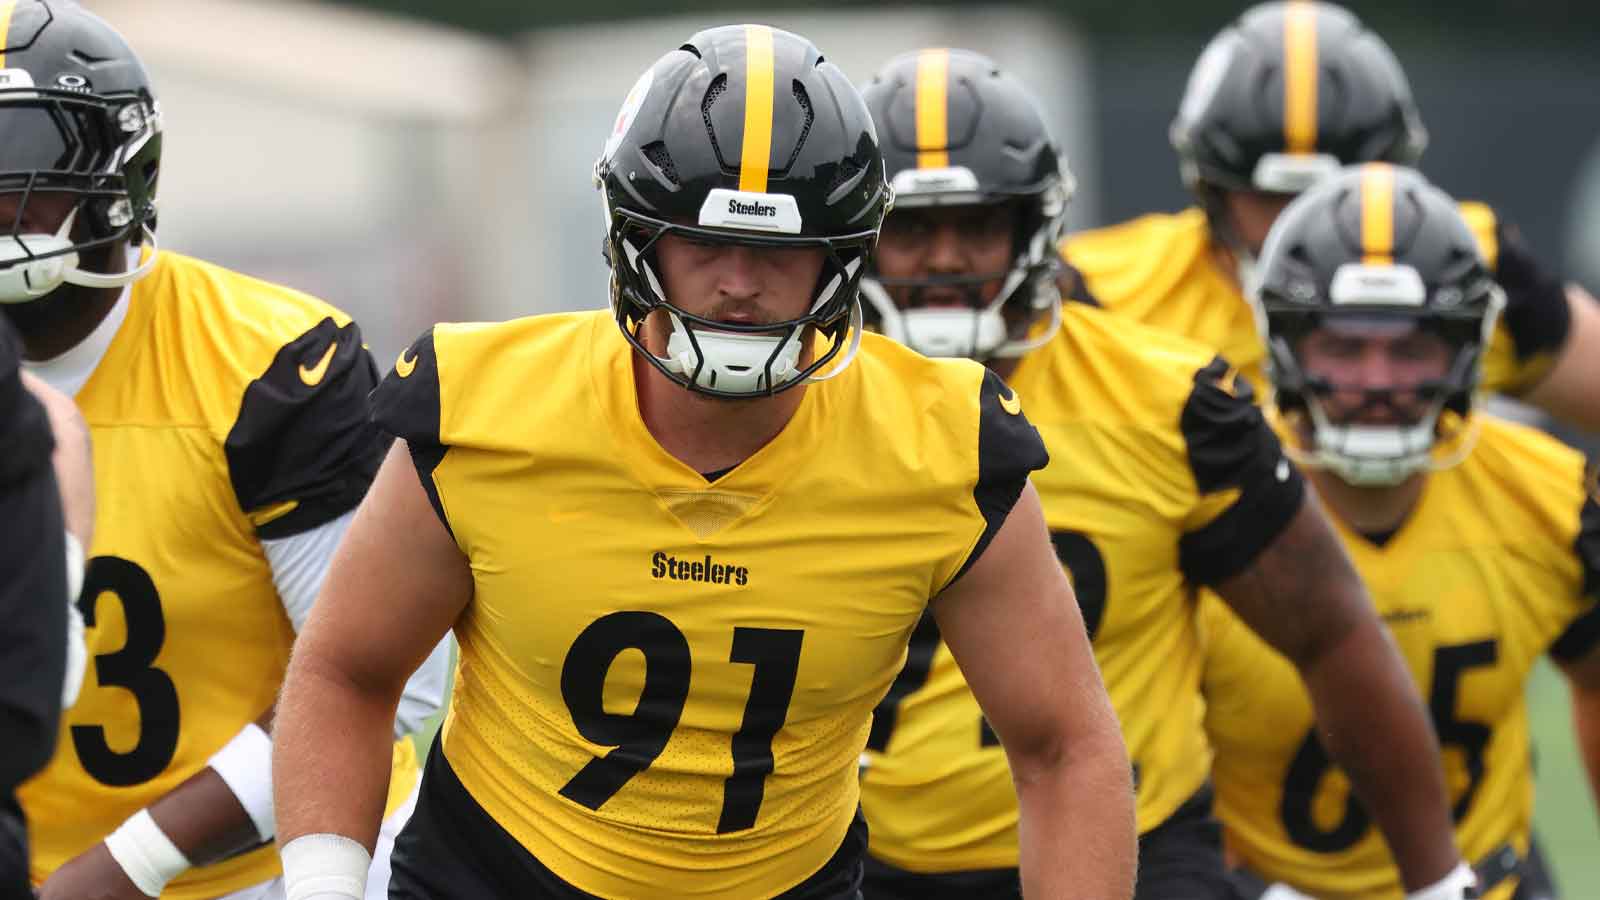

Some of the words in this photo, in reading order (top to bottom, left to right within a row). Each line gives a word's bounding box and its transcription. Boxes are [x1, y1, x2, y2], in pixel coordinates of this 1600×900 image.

[728, 199, 777, 217] Steelers
[651, 551, 749, 586] Steelers
[557, 610, 805, 835] 91
